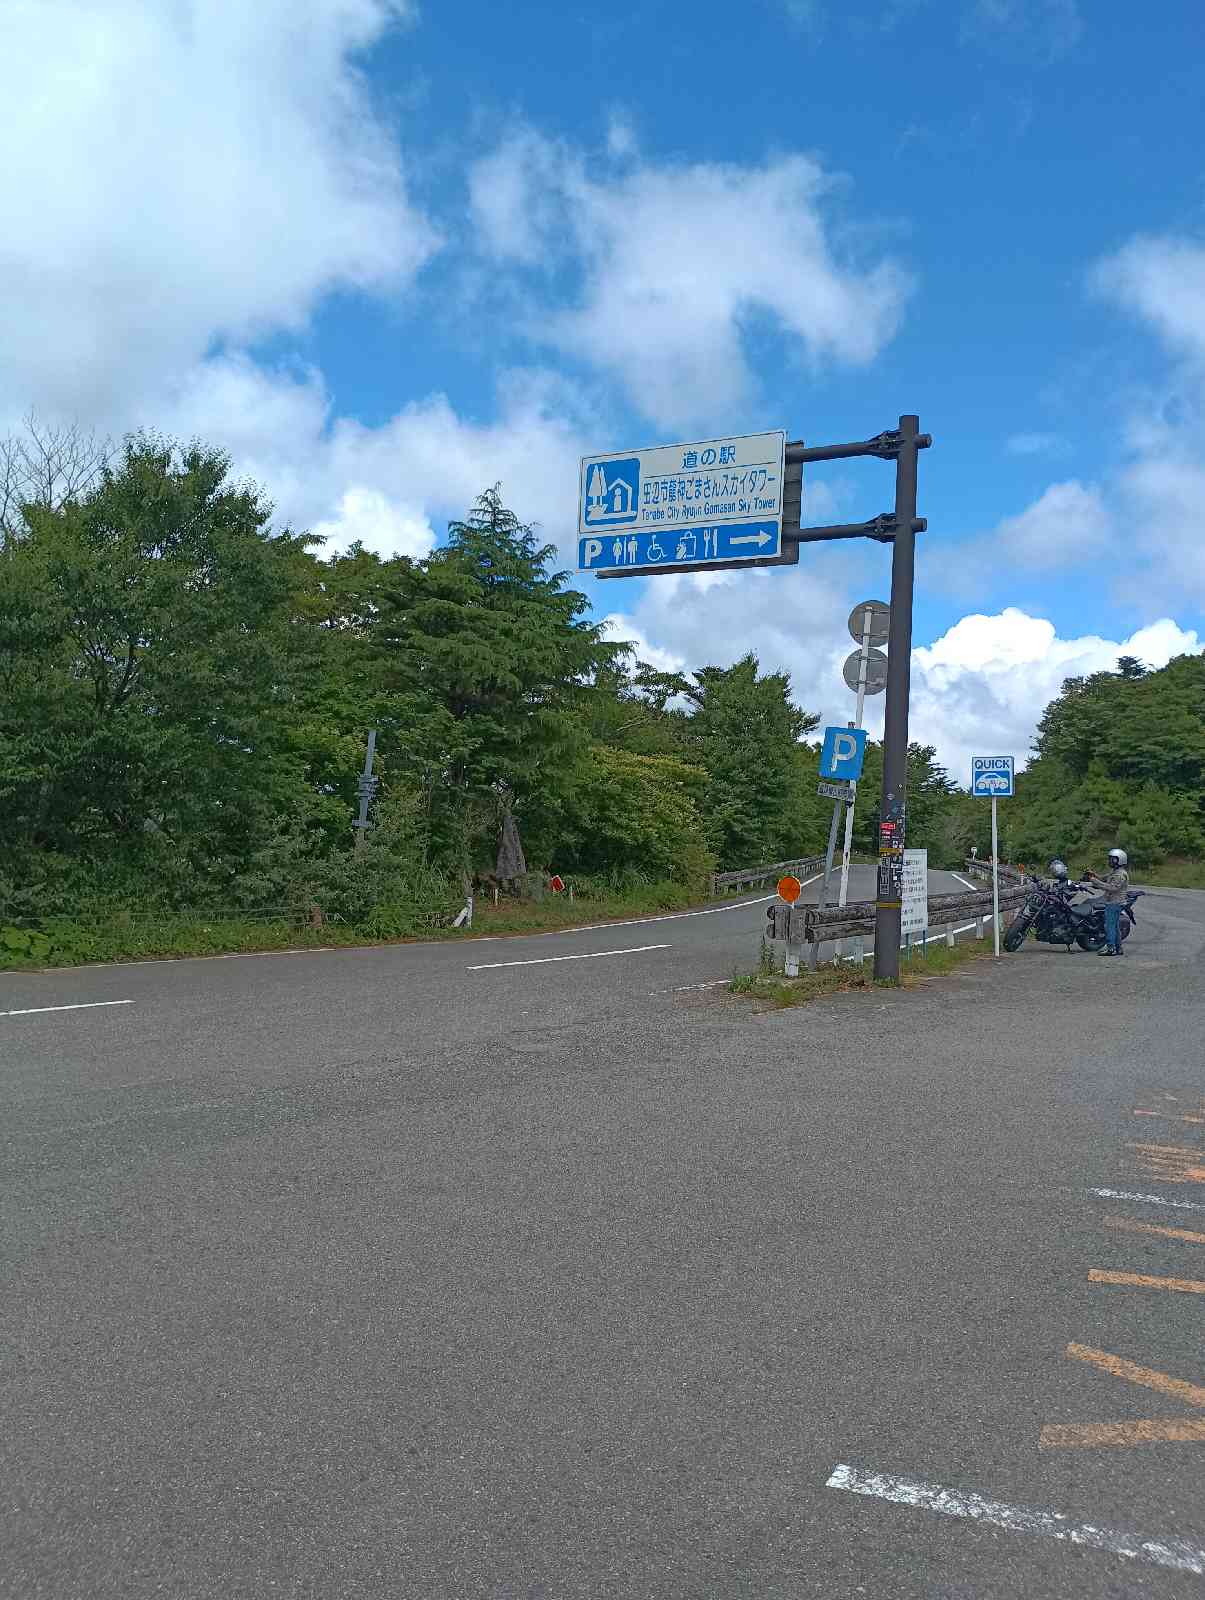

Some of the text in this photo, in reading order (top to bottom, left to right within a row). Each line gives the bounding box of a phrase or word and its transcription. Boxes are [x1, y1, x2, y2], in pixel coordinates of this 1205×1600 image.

[681, 445, 736, 469] 道の駅
[641, 496, 776, 520] Tanabe City Ryujin Gomasan Sky Tower
[584, 538, 602, 567] P
[831, 733, 857, 772] P
[974, 759, 1010, 770] QUICK
